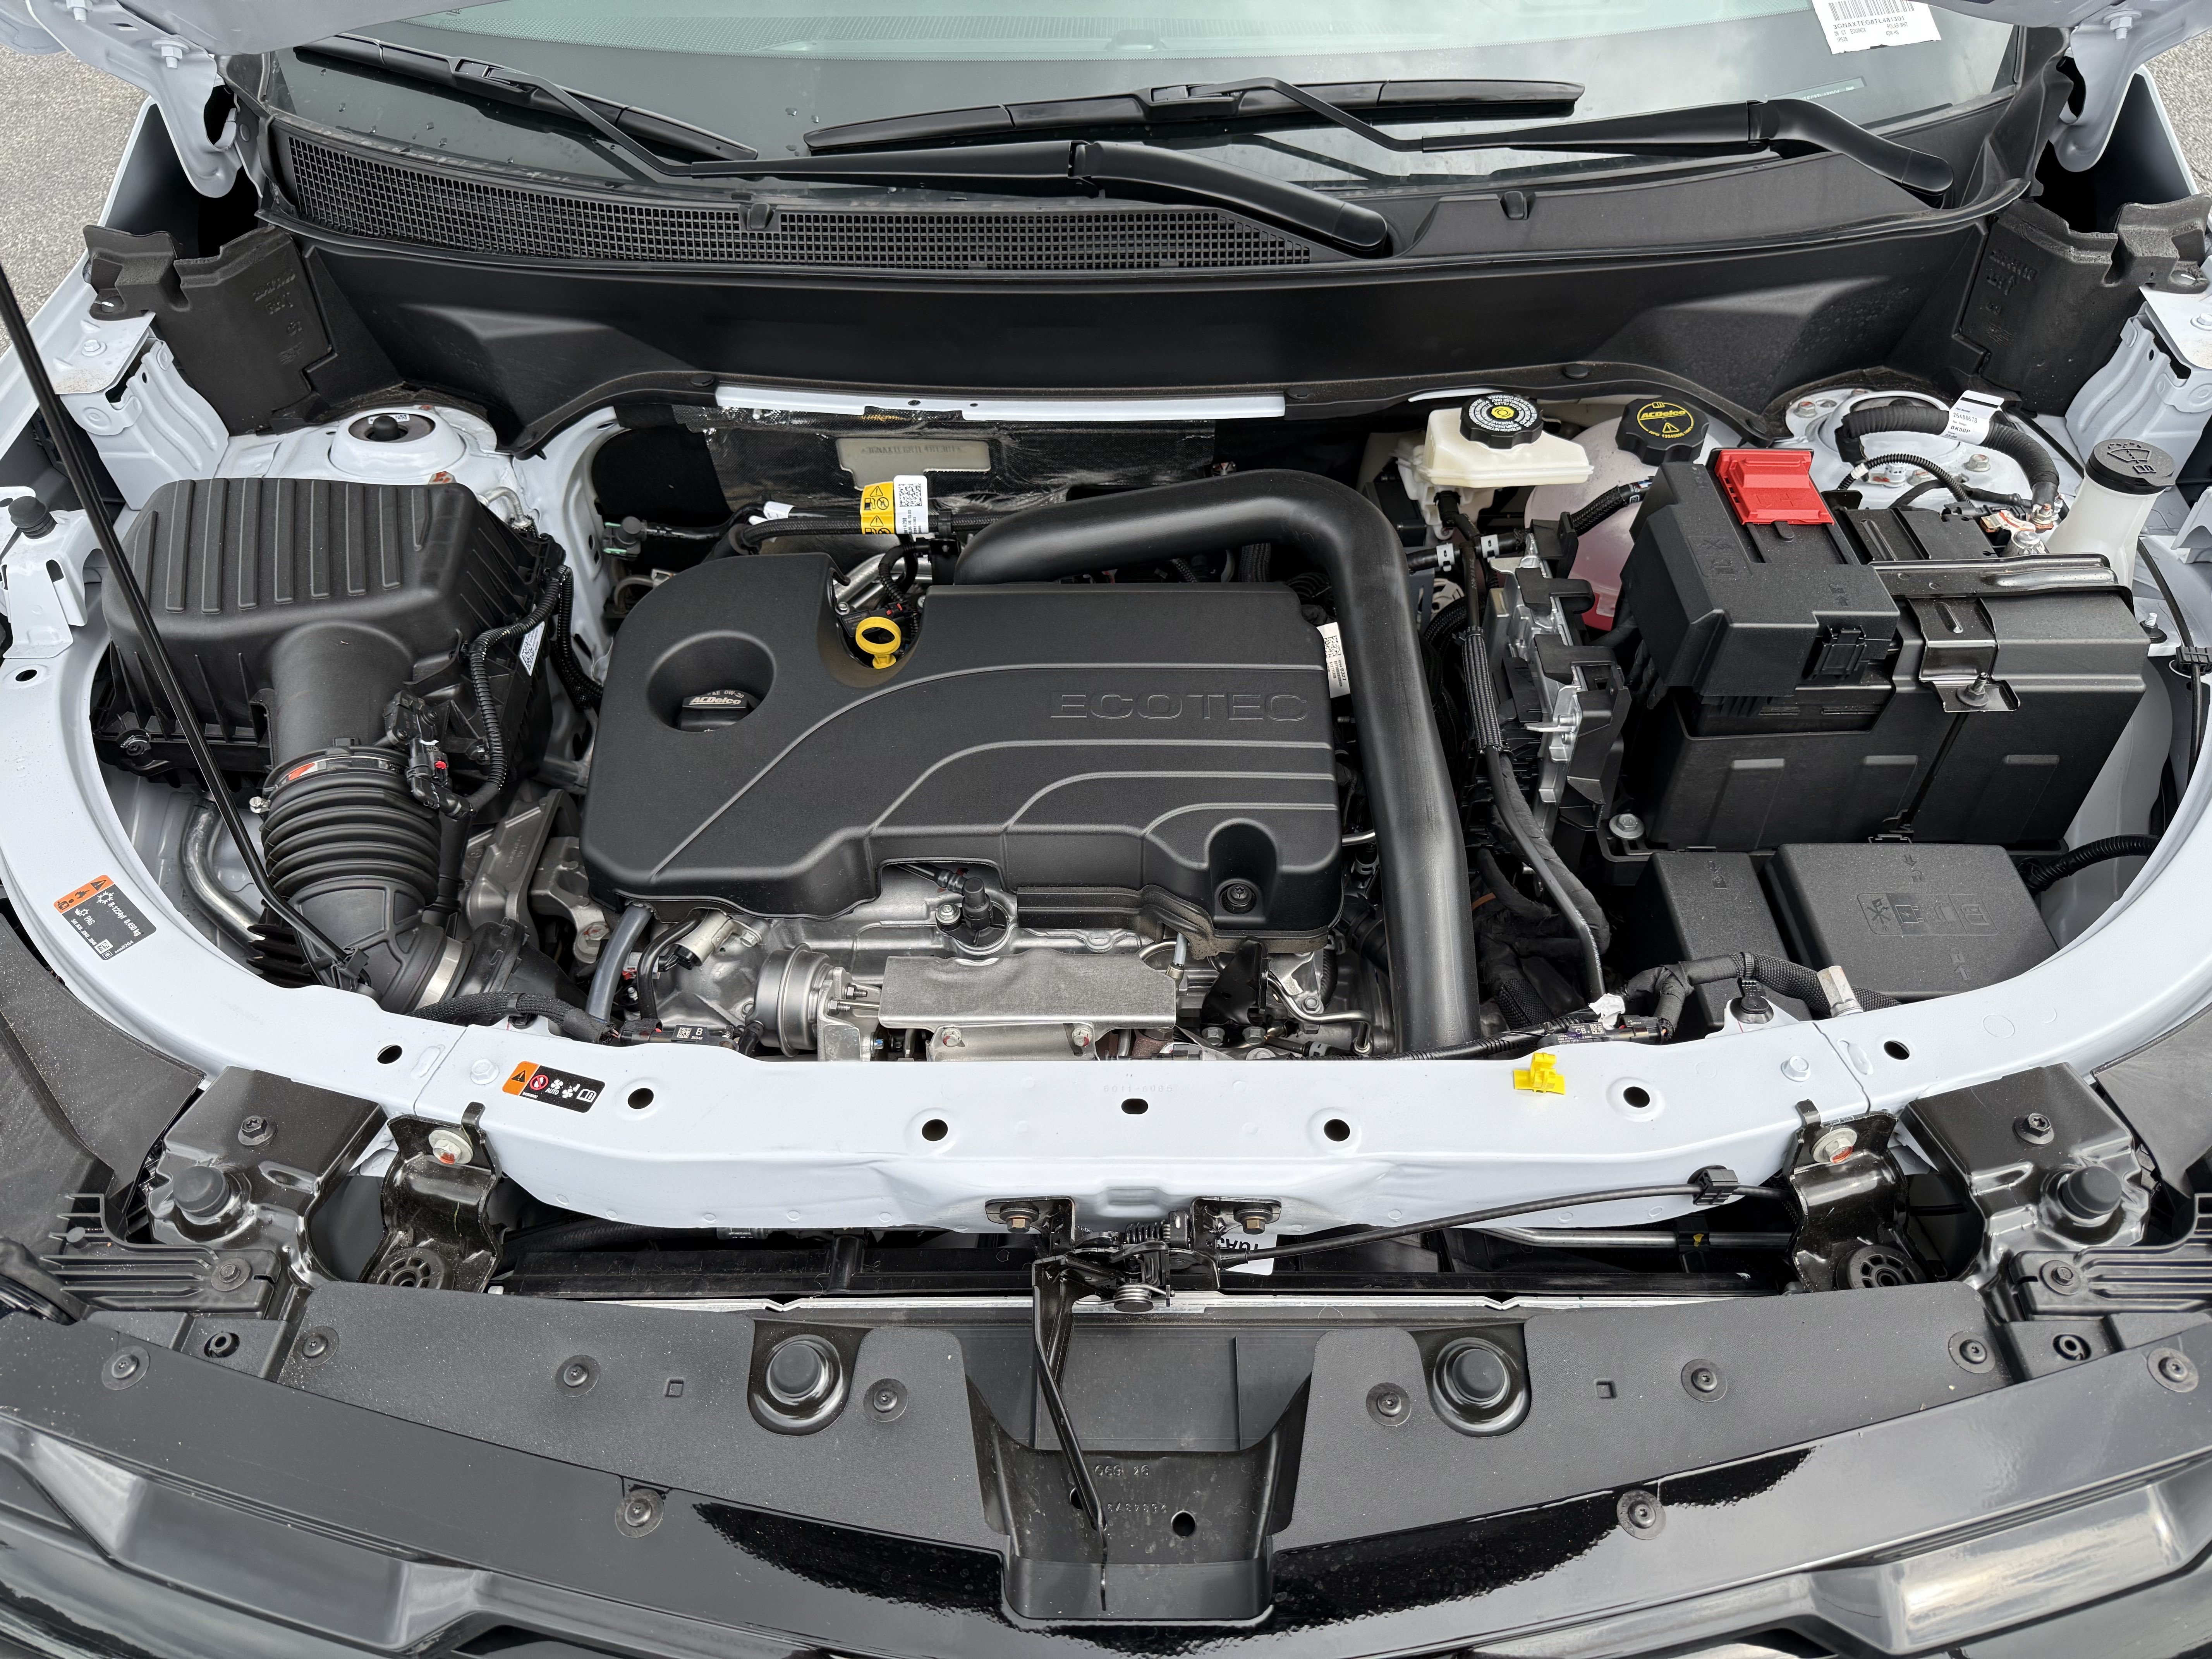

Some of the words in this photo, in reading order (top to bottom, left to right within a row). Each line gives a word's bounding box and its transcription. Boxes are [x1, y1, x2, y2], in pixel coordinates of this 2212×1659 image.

[1641, 410, 1686, 419] ACDelco
[1050, 691, 1307, 721] ECOTEC
[84, 915, 96, 926] PAG
[108, 902, 127, 920] R-1234yf
[124, 919, 136, 931] 0.450
